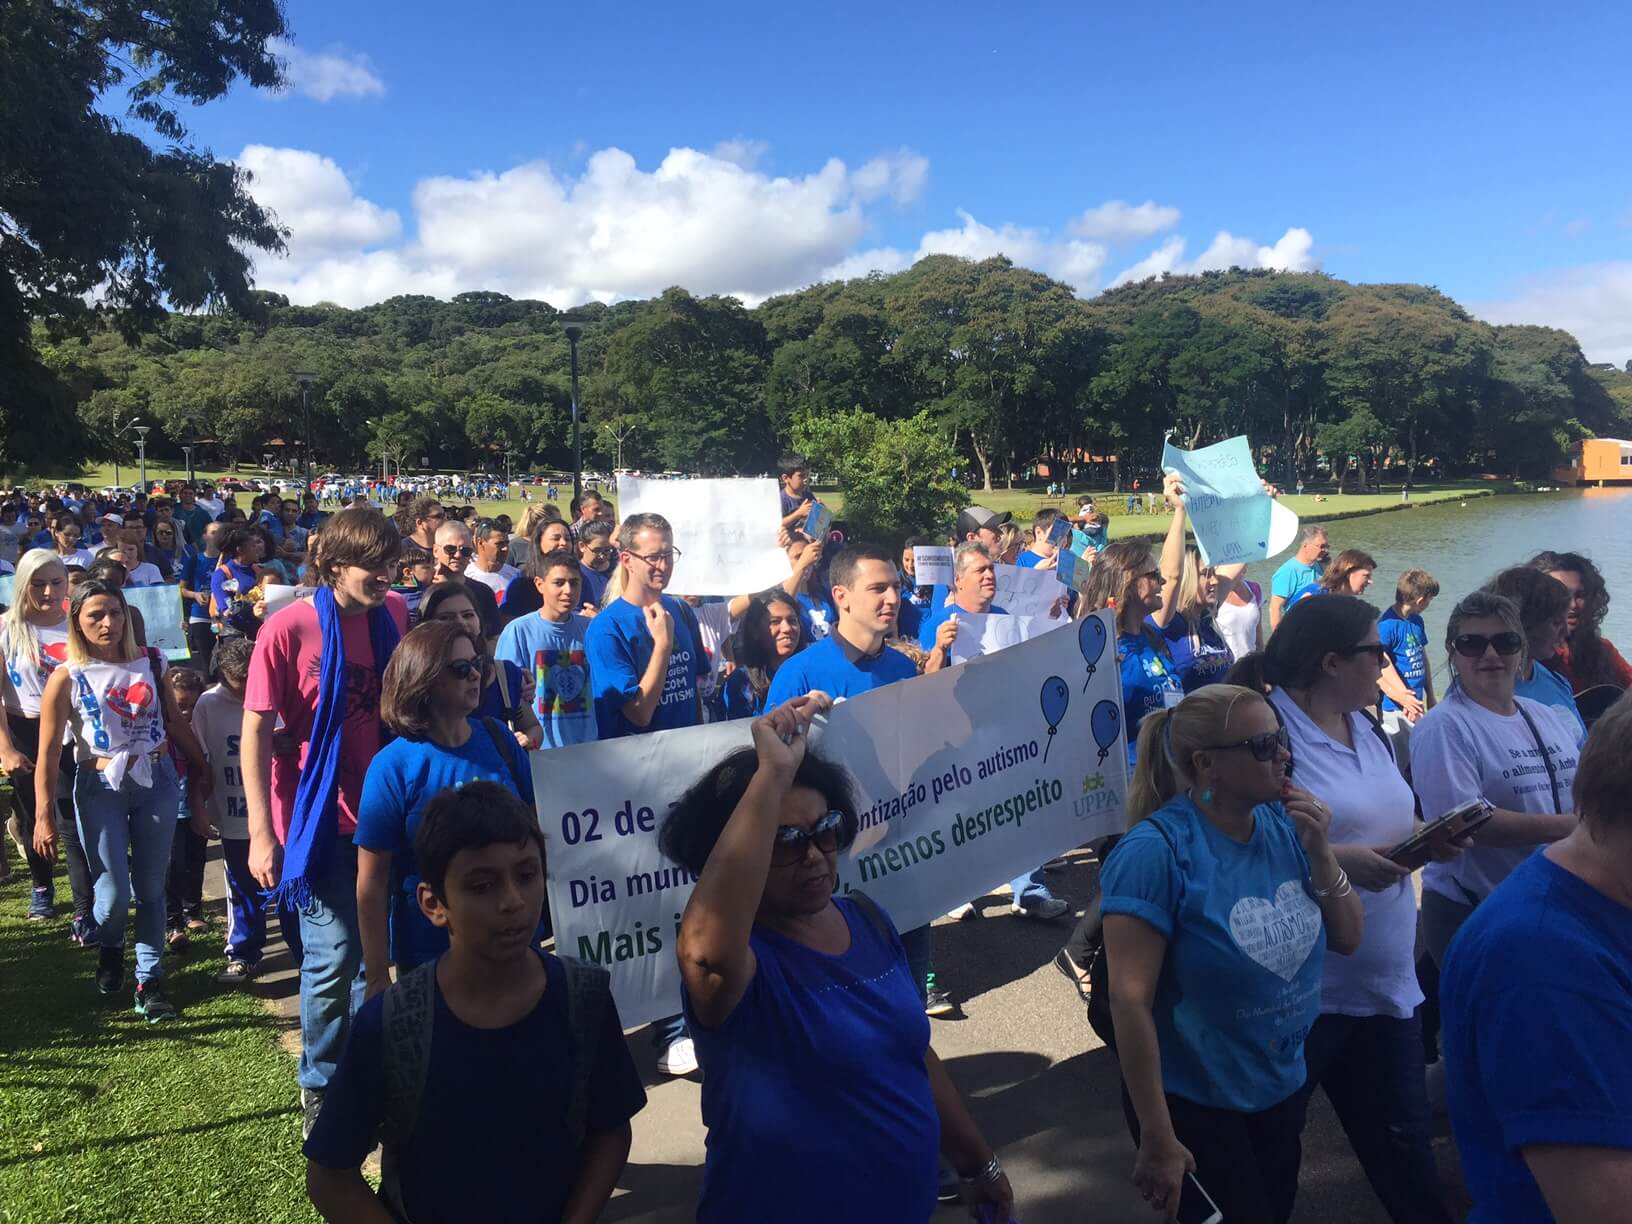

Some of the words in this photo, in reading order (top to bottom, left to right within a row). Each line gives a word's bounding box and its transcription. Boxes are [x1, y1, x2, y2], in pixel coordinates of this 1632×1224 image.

[660, 687, 695, 704] UTISM
[857, 783, 926, 833] ntização
[932, 764, 972, 804] pelo
[977, 740, 1039, 780] autismo
[1072, 789, 1121, 818] UPPA
[561, 807, 603, 845] 02
[614, 800, 656, 836] de
[858, 829, 945, 883] menos
[951, 778, 1063, 847] desrespeito
[569, 875, 616, 908] Dia
[577, 921, 663, 965] Mais
[1263, 911, 1306, 950] AUTISMO
